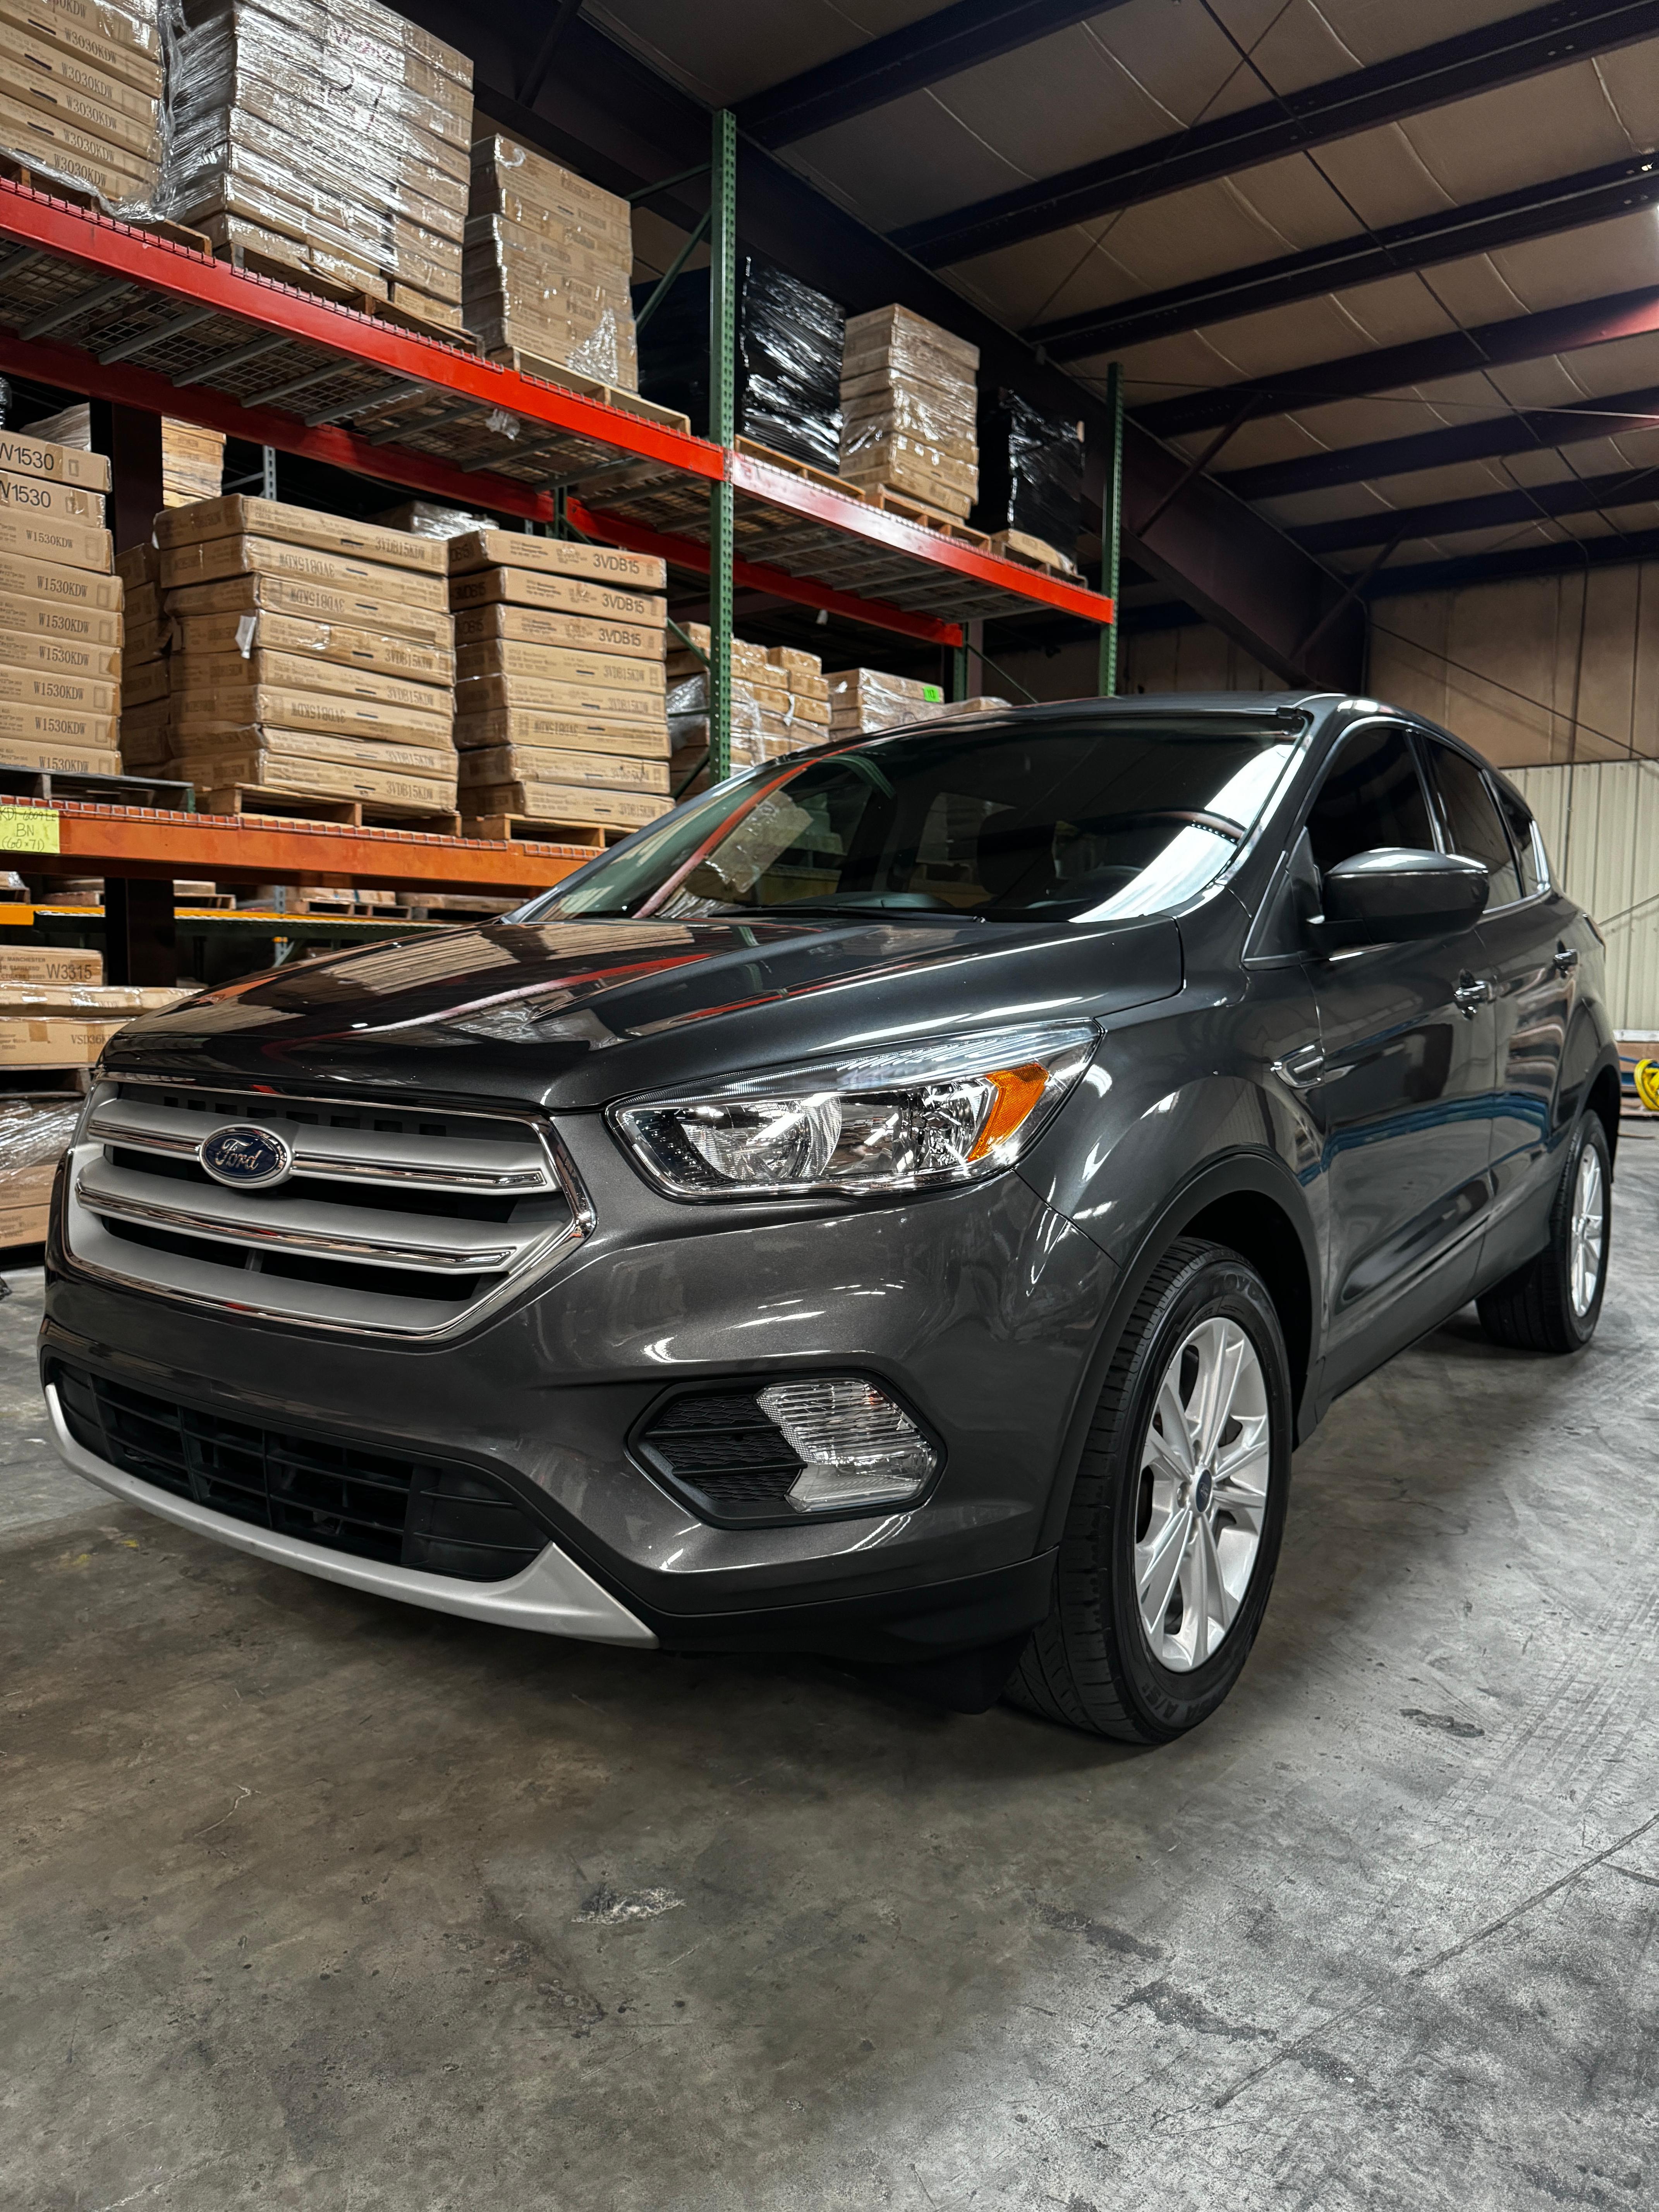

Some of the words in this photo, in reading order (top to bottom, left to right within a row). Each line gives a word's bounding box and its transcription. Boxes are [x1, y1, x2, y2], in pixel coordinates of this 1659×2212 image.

[65, 27, 116, 64] W3030KDW
[62, 62, 112, 99] W3030KDW
[67, 95, 116, 129] W3030KDW
[63, 128, 115, 163] W3030KDW
[54, 154, 106, 187] W3030KDW
[26, 530, 73, 549] W1530KDW
[593, 553, 640, 574] 3VDB15
[37, 576, 88, 598] W1530KDW
[602, 593, 644, 614] 3VDB15
[39, 613, 90, 634] W1530KDW
[599, 628, 641, 647] 3VDB15
[39, 646, 90, 666] W1530KDW
[34, 681, 84, 700] W1530KDW
[35, 716, 86, 735] W1530KDW
[39, 756, 89, 773] W1530KDW
[16, 823, 34, 837] BN
[46, 964, 92, 979] W3315
[215, 1138, 263, 1170] Ford
